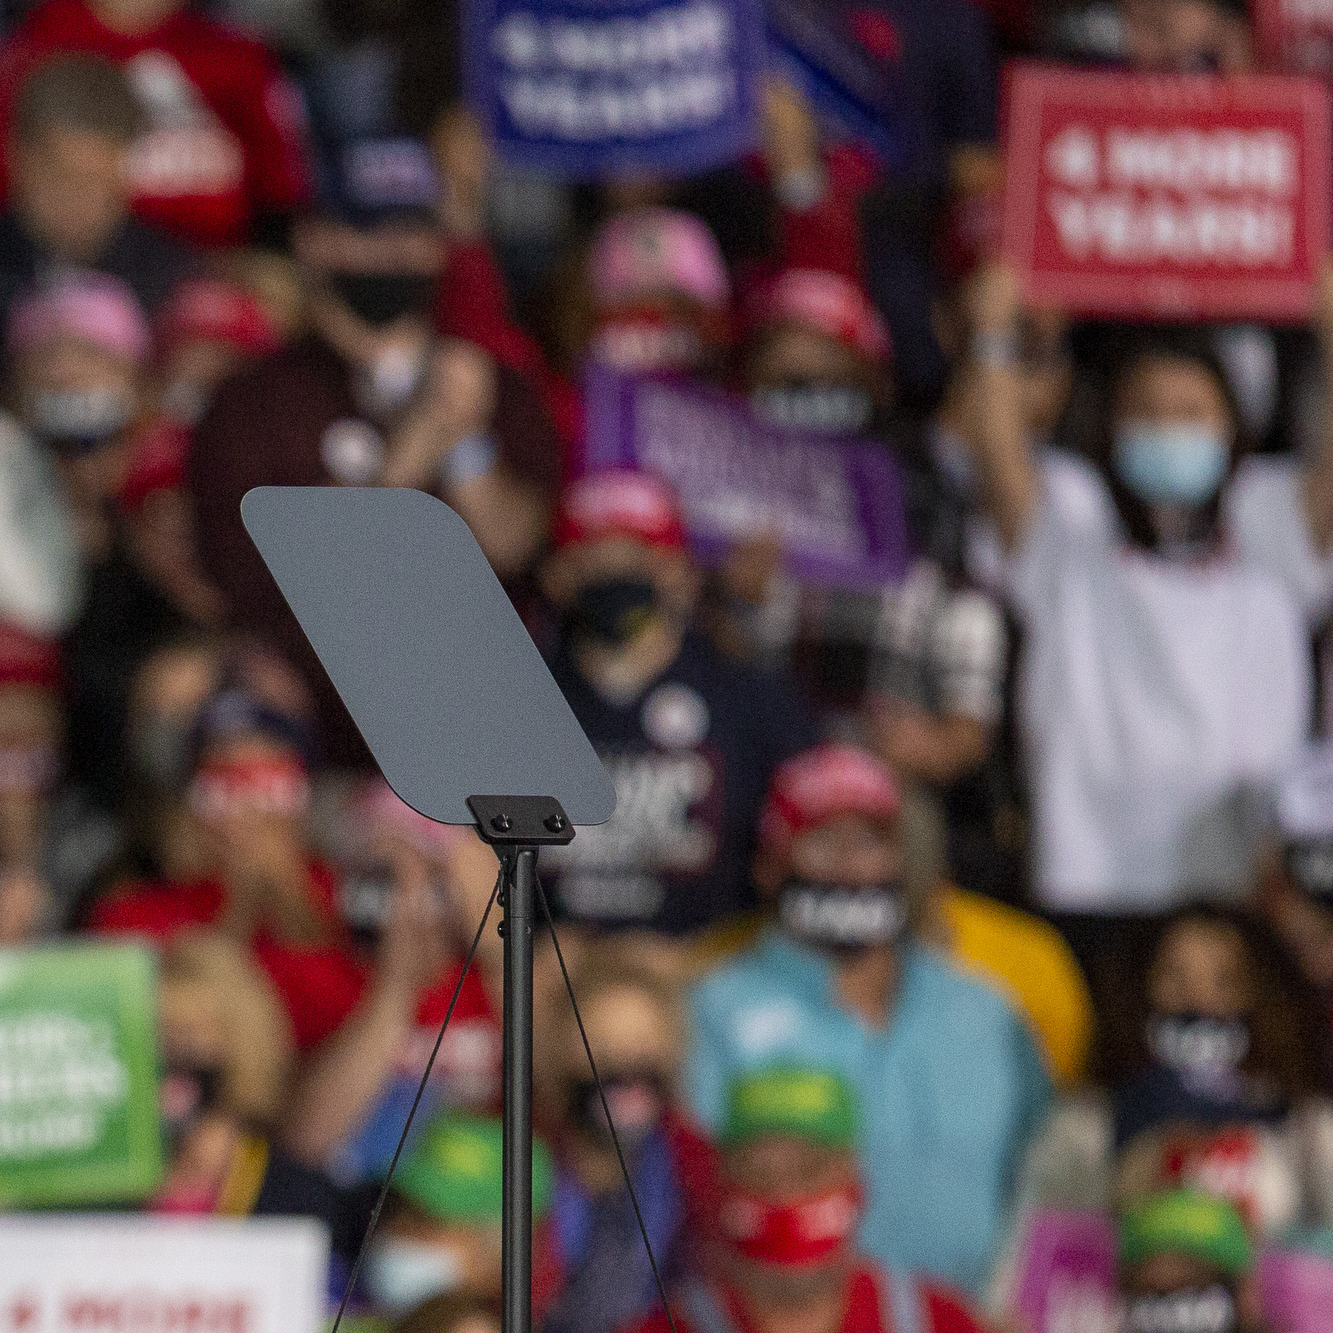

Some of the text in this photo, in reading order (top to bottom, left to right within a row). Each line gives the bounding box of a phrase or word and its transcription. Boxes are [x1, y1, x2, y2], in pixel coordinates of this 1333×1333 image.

[1047, 126, 1294, 192] 4 MORE
[1044, 194, 1297, 261] YEARS!
